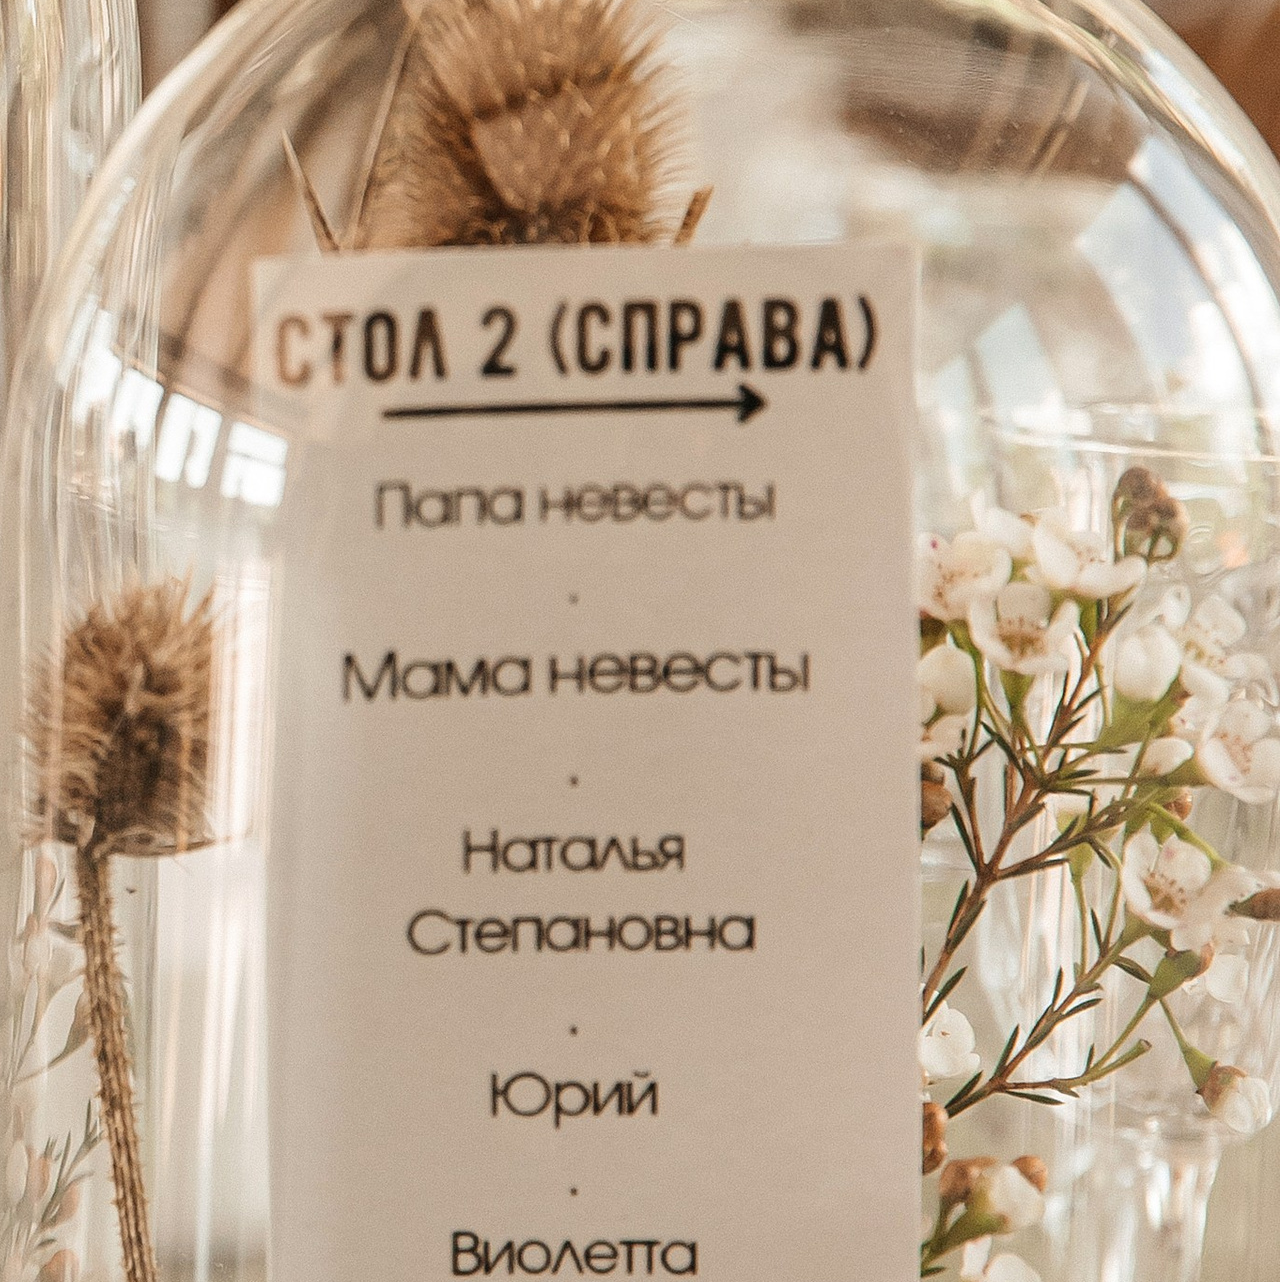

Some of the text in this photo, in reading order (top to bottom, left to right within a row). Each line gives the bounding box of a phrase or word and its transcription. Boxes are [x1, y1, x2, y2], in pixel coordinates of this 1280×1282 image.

[276, 296, 876, 388] СТОЛ 2 (СПРАВА)
[376, 482, 774, 528] Папа невесты
[344, 651, 809, 700] Мама невесты
[463, 830, 684, 873] Наталья
[406, 909, 755, 955] Степановна
[491, 1072, 658, 1128] Юрий
[452, 1231, 697, 1276] Виолетта
